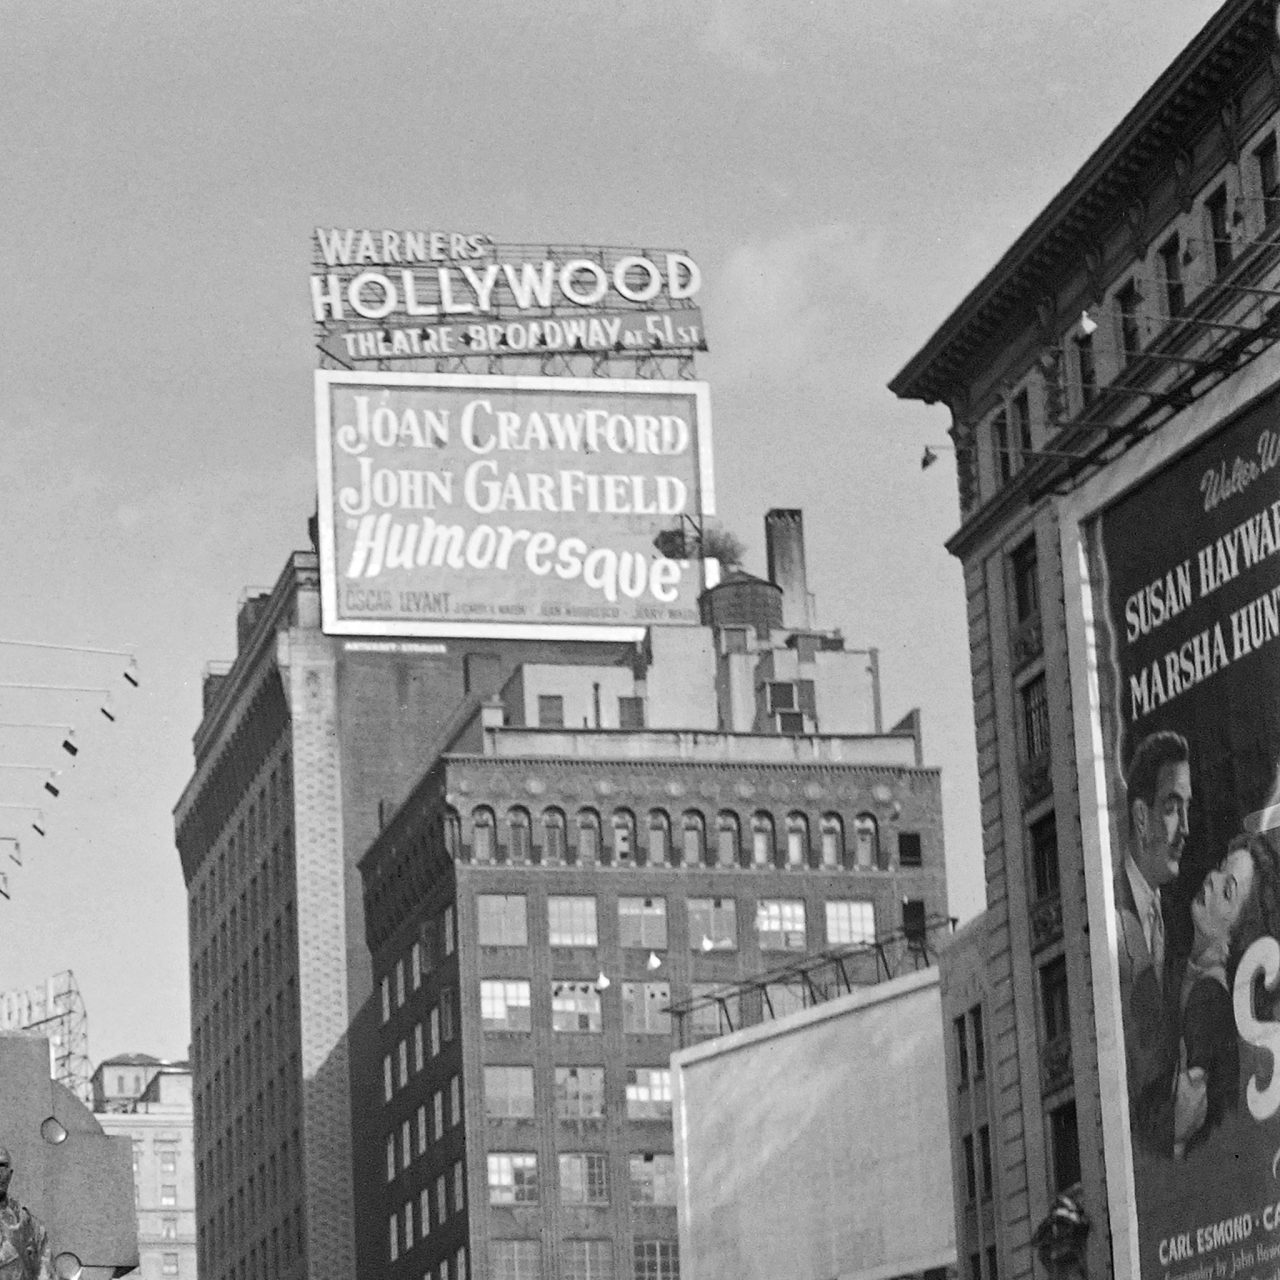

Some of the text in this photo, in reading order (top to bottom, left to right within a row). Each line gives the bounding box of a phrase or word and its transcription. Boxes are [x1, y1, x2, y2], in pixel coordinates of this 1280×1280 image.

[310, 254, 702, 321] HOLLYWOOD
[344, 327, 453, 357] THEATRE
[466, 317, 621, 351] BROADWAY
[337, 395, 689, 455] JOAN CRAWFORD
[338, 457, 688, 514] JOHN GARFIELD
[1125, 559, 1191, 643] SUSAN
[1129, 621, 1230, 721] MARSHA
[1159, 1231, 1194, 1266] CARL
[1197, 1213, 1253, 1254] ESMOND
